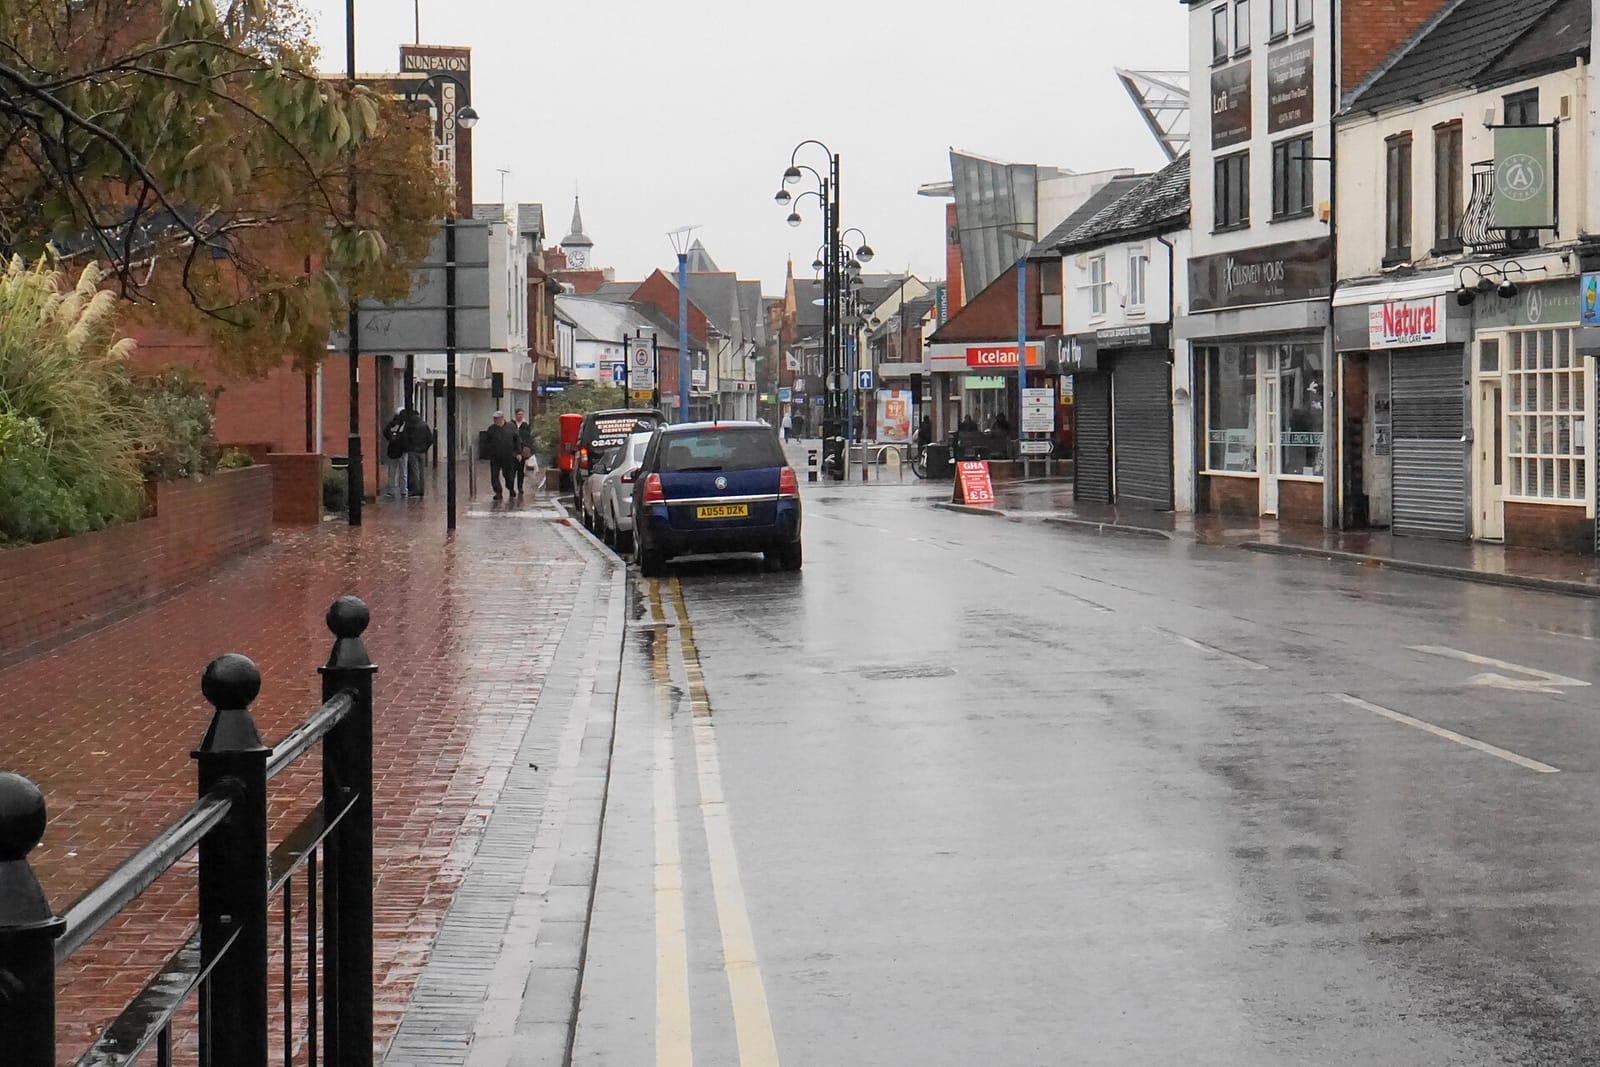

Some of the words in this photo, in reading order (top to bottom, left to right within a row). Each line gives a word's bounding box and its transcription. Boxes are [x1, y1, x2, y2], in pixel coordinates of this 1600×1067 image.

[405, 56, 467, 71] NUNEATON
[1213, 90, 1228, 114] Loft
[1383, 296, 1437, 338] Natural
[1397, 336, 1409, 344] NAIL
[1409, 334, 1421, 343] CARE
